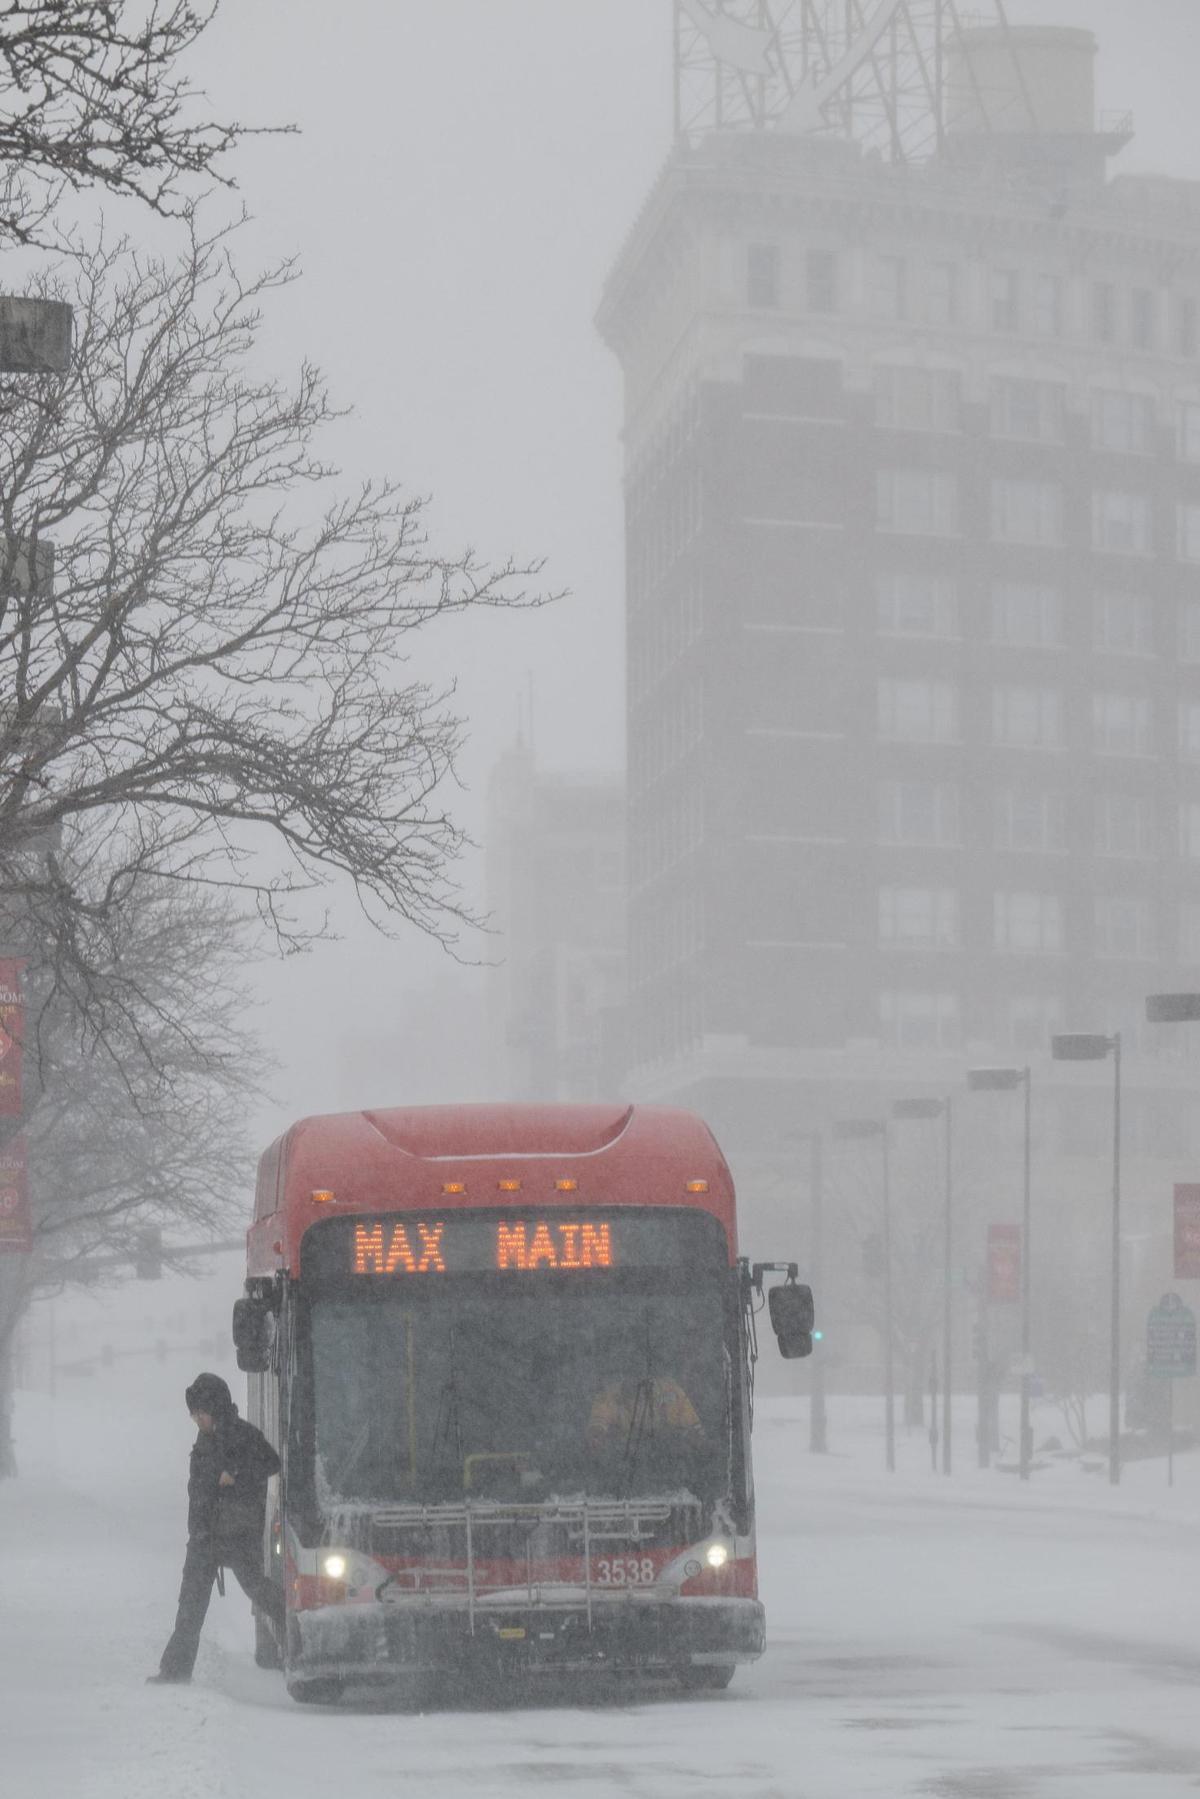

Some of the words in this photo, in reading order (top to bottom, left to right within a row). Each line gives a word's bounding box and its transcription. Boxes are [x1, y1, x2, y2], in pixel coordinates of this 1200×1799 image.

[355, 1222, 446, 1273] MAX
[498, 1220, 612, 1269] MAIN
[598, 1558, 655, 1584] 3538
